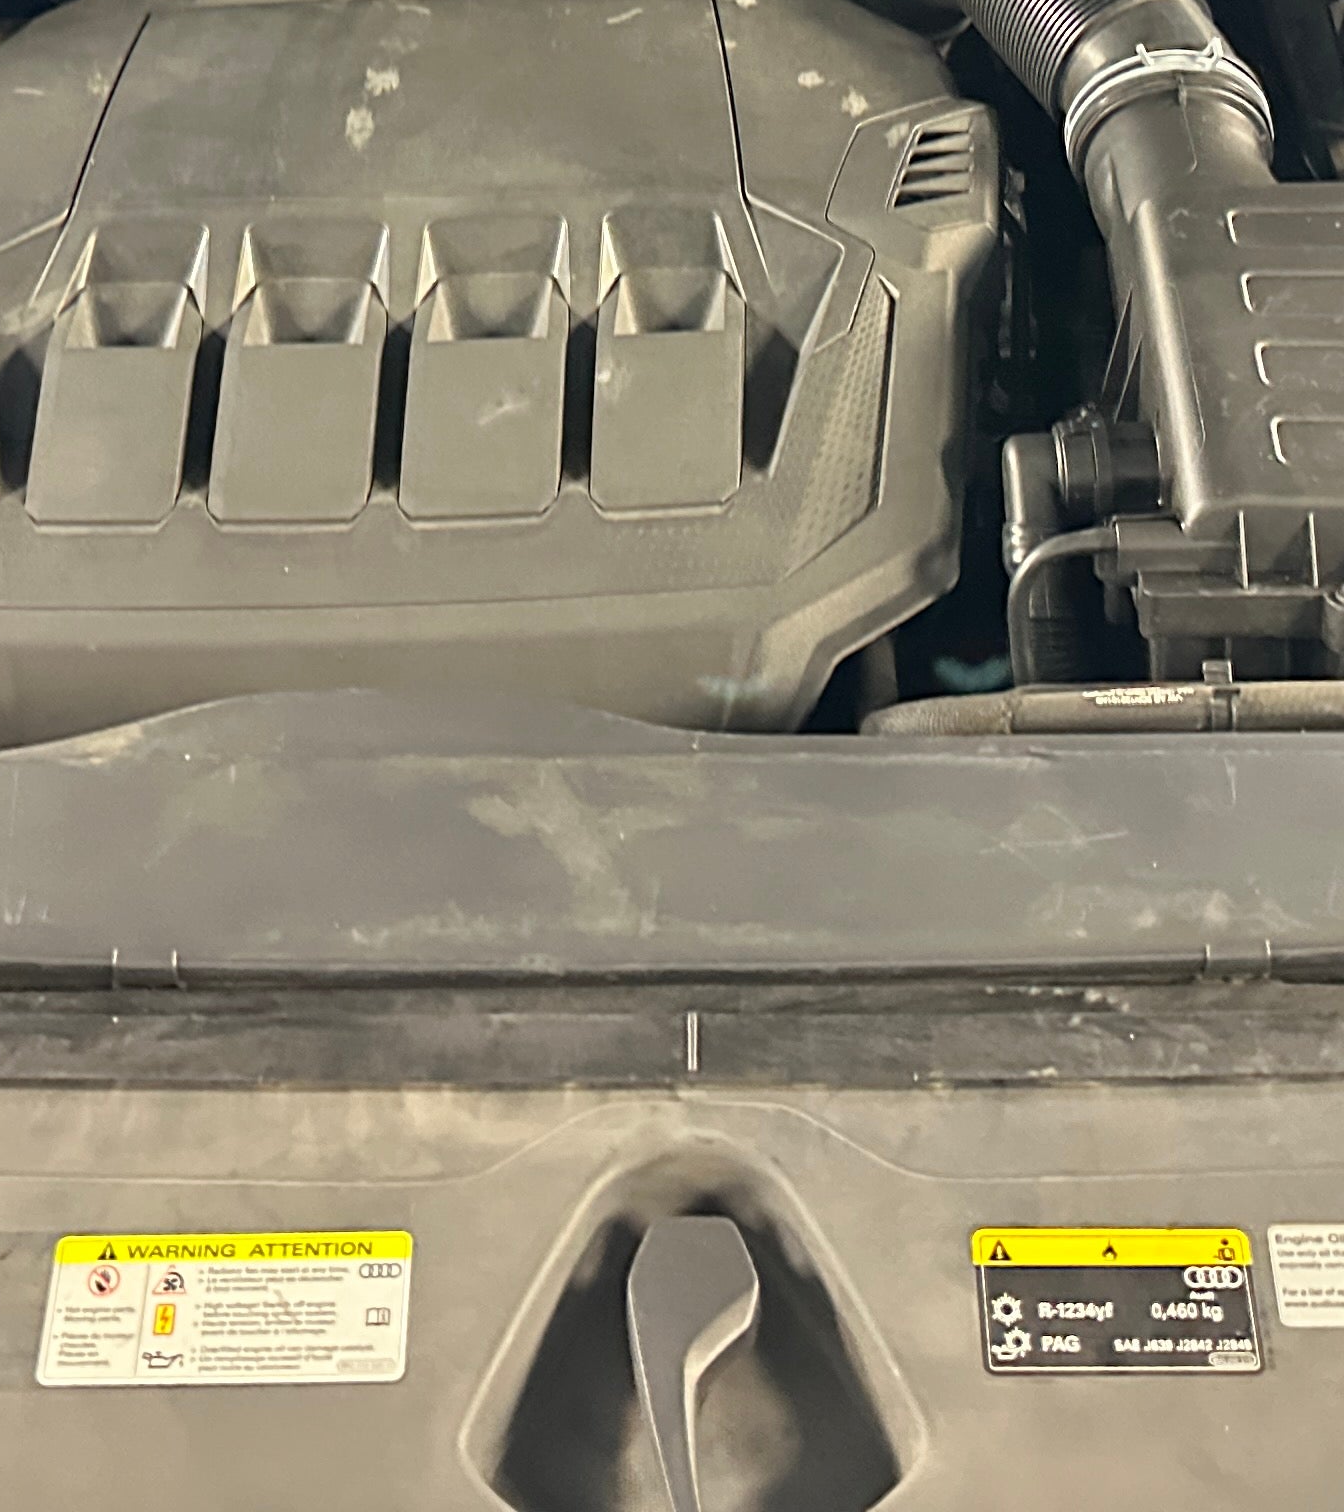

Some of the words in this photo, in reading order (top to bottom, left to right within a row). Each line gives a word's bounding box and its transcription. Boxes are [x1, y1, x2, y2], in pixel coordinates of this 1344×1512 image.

[1275, 1233, 1323, 1245] Engine
[127, 1243, 236, 1259] WARNING
[248, 1242, 373, 1257] ATTENTION
[1037, 1301, 1114, 1322] R-1234yf
[1201, 1301, 1225, 1322] kg
[1040, 1334, 1081, 1353] PAG
[1113, 1339, 1141, 1352] SAE
